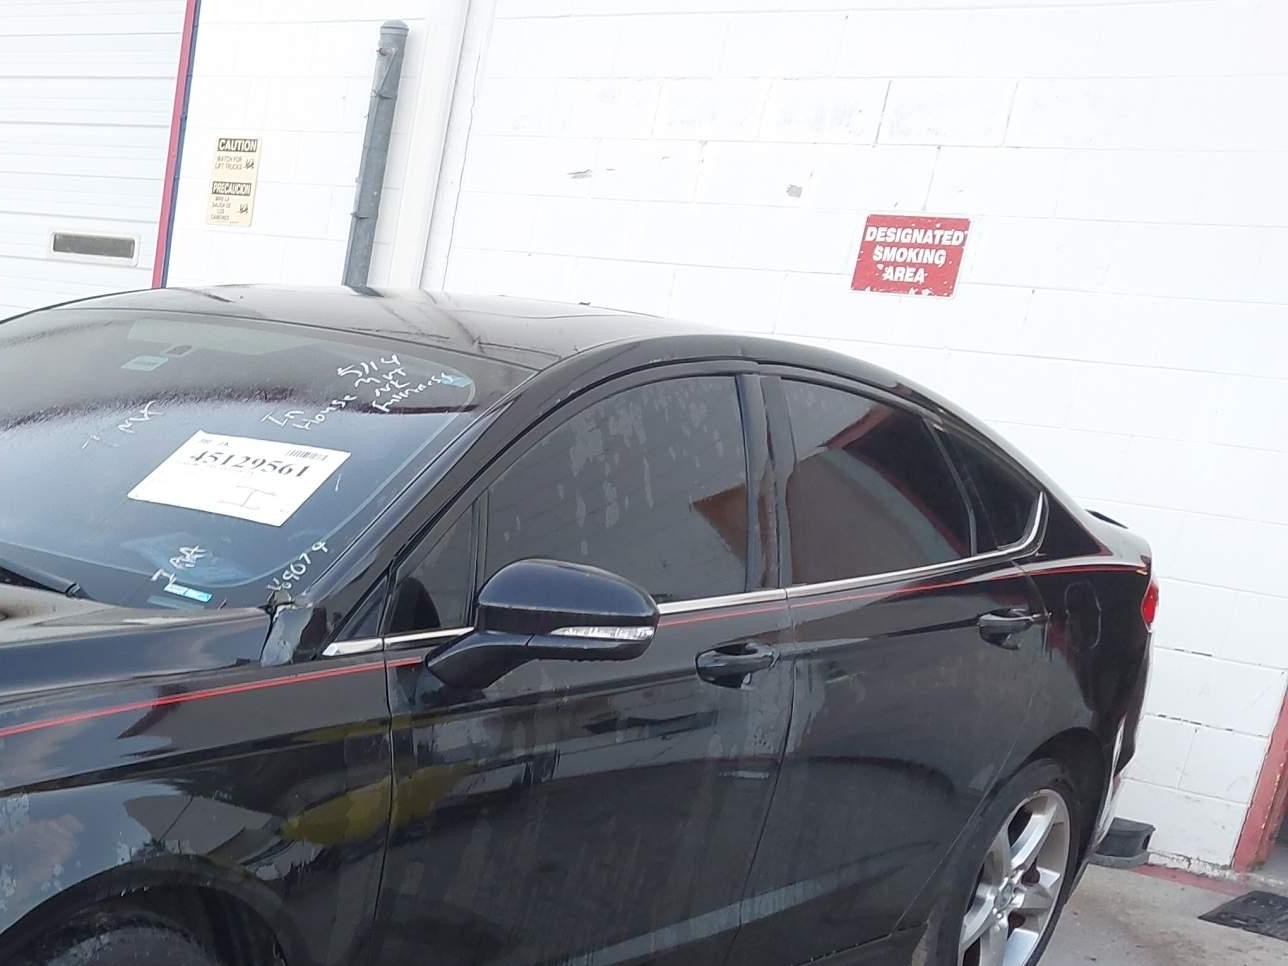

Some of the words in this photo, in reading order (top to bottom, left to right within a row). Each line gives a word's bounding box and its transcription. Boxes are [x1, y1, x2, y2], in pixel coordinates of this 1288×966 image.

[219, 139, 256, 151] CAUTION
[865, 226, 964, 246] DESIGNATED
[872, 244, 947, 267] SMOKING
[882, 265, 925, 284] AREA
[190, 450, 311, 477] 45129561
